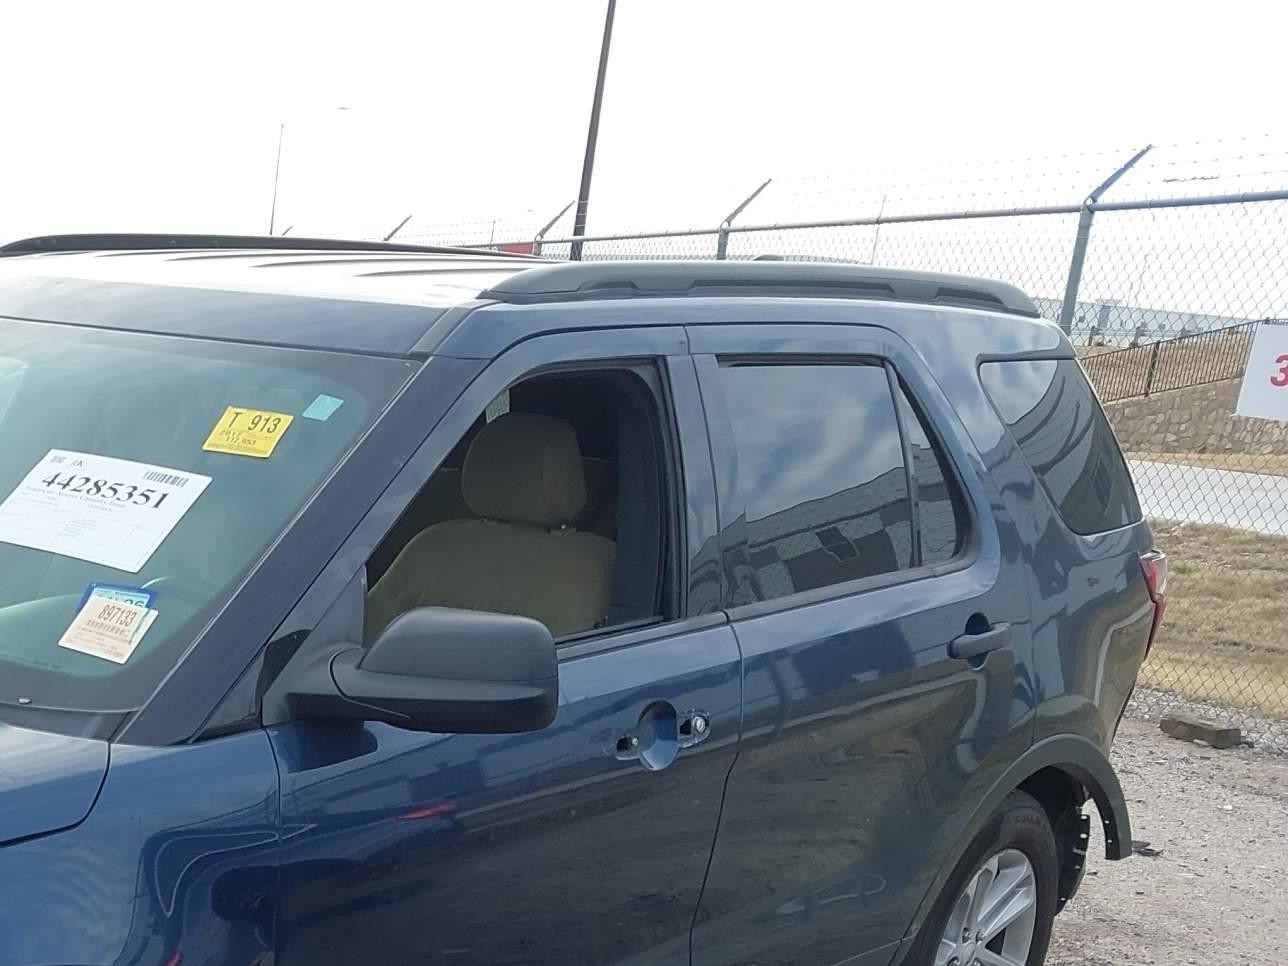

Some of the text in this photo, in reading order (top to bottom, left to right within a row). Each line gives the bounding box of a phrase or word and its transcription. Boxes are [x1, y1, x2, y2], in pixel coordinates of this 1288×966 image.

[228, 412, 282, 434] T 913
[42, 471, 170, 509] 44285351
[97, 604, 138, 627] 897133
